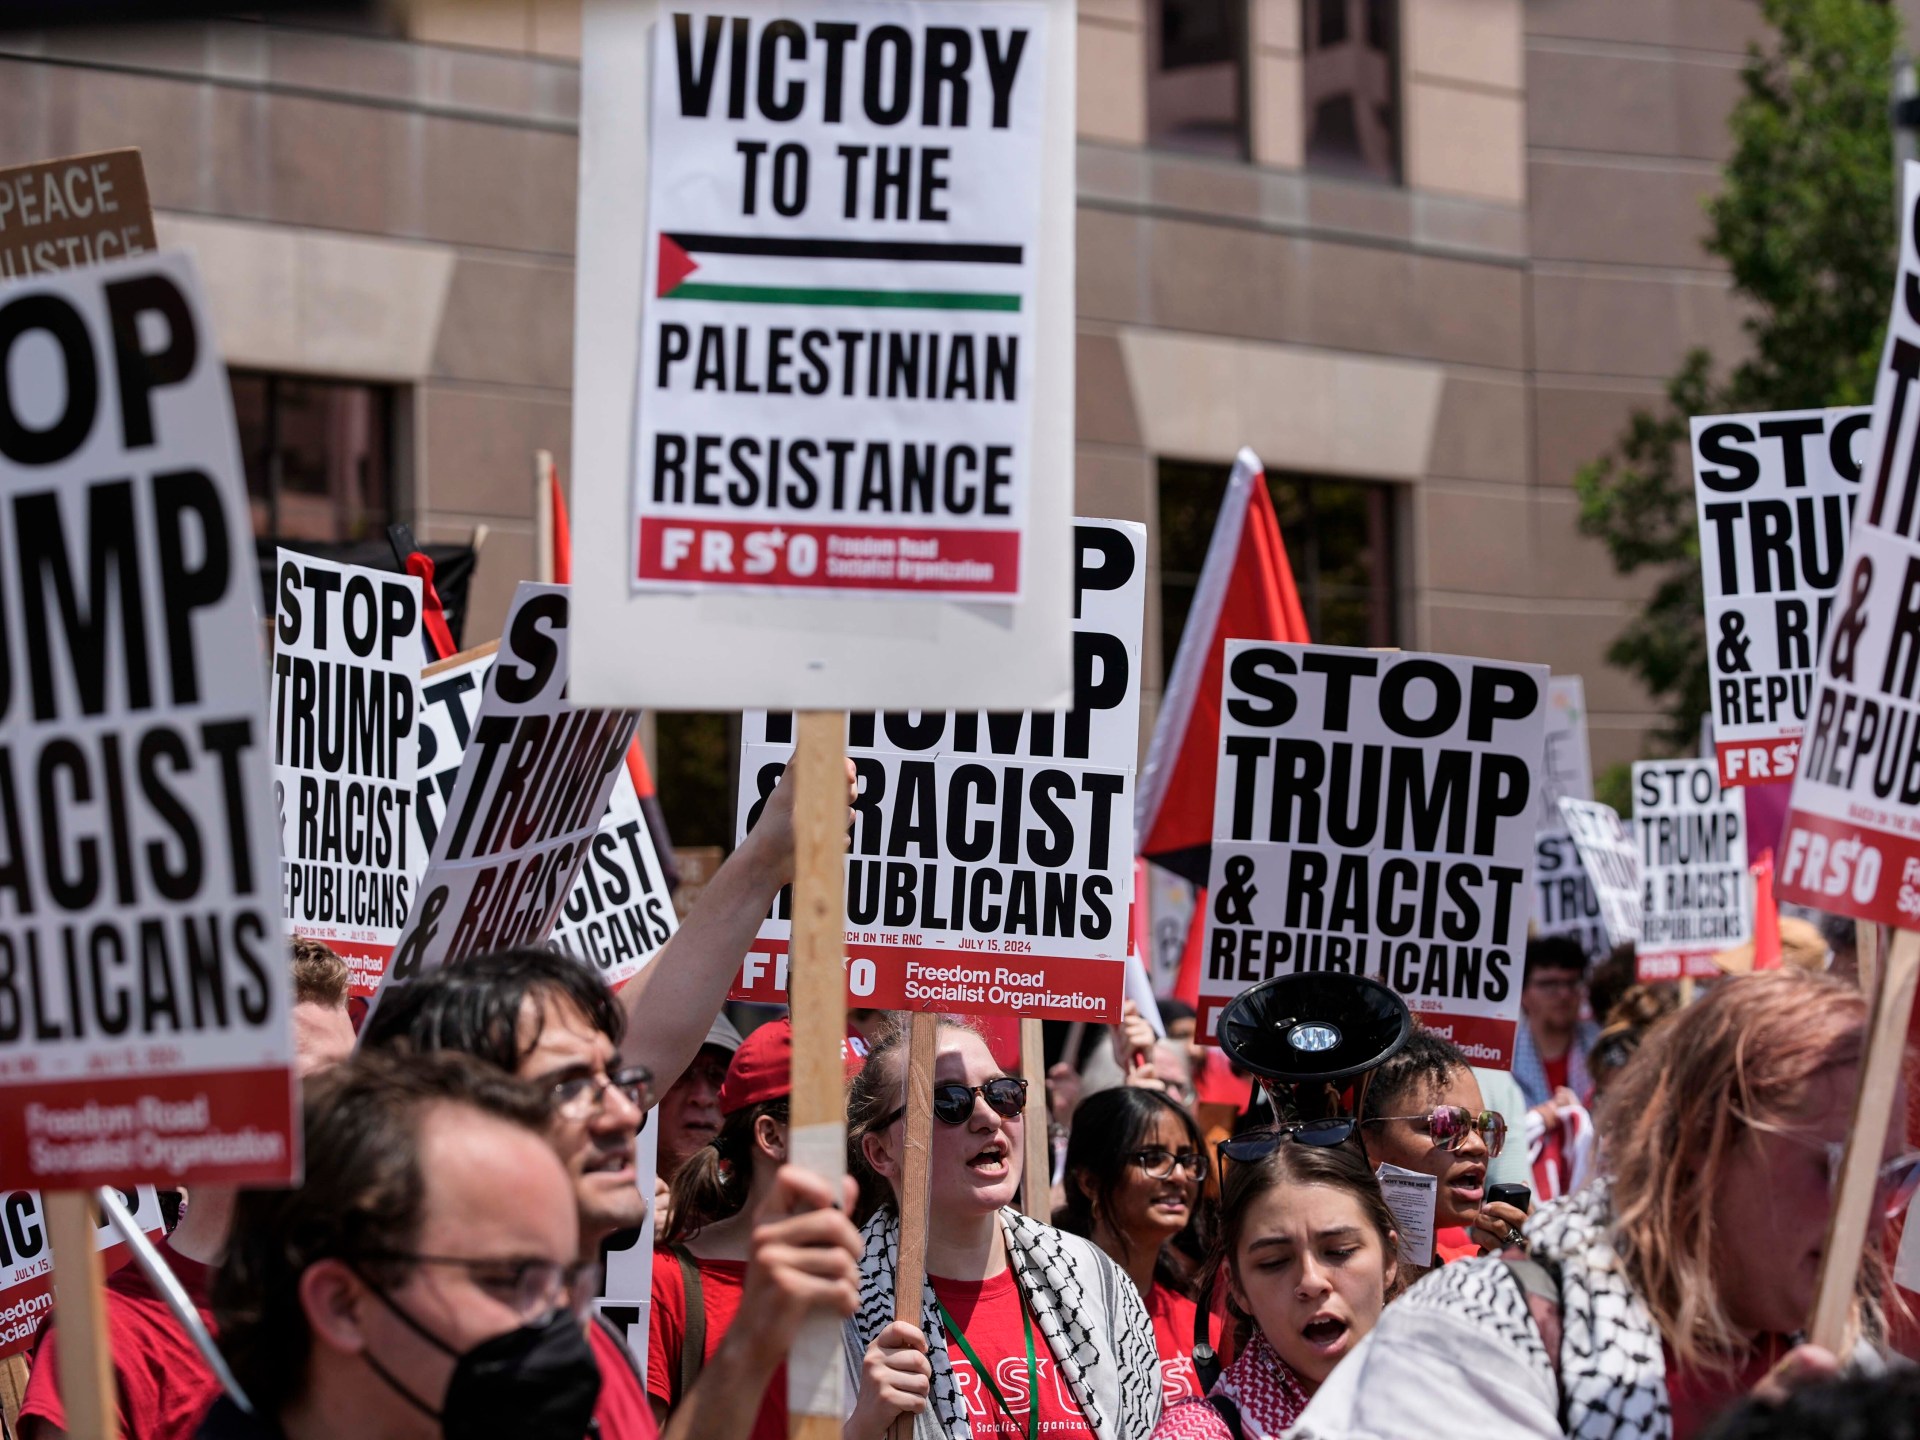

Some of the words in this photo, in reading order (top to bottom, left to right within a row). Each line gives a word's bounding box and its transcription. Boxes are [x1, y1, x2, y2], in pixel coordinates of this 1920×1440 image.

[672, 12, 1029, 130] VICTORY
[735, 140, 810, 217] TO
[837, 144, 951, 223] THE
[0, 225, 145, 283] USTICE
[656, 322, 1018, 402] PALESTINIAN
[652, 432, 1013, 517] RESISTANCE
[1699, 413, 1872, 492] STO
[896, 559, 994, 582] Organization
[1705, 493, 1857, 596] TRU
[0, 468, 233, 727] MP
[277, 560, 416, 660] STOP
[1717, 610, 1751, 673] &
[275, 653, 414, 781] TRUMP
[1226, 648, 1539, 743] STOP
[1225, 735, 1530, 857] TRUMP
[1724, 742, 1800, 780] FRS
[298, 775, 411, 870] RACIST
[848, 757, 1124, 871] RACIST
[1642, 813, 1738, 866] TRUMP
[281, 861, 409, 930] EPUBLICANS
[766, 860, 1113, 941] UBLICANS
[1214, 853, 1258, 926] &
[1284, 848, 1523, 946] RACIST
[1535, 875, 1601, 926] TRU
[842, 932, 860, 944] RCH
[863, 933, 876, 945] ON
[879, 934, 898, 946] THE
[902, 934, 922, 946] RNC
[958, 937, 983, 950] JULY
[987, 939, 1001, 953] 15,
[1005, 940, 1031, 953] 2024
[906, 962, 990, 983] Freedom
[995, 966, 1044, 988] Road
[905, 982, 984, 1003] Socialist
[988, 987, 1106, 1010] Organization
[1427, 1024, 1453, 1039] oad
[1454, 1041, 1501, 1060] ization
[14, 1264, 36, 1282] JULY
[38, 1258, 52, 1272] 15,
[1037, 1420, 1090, 1433] rganizat
